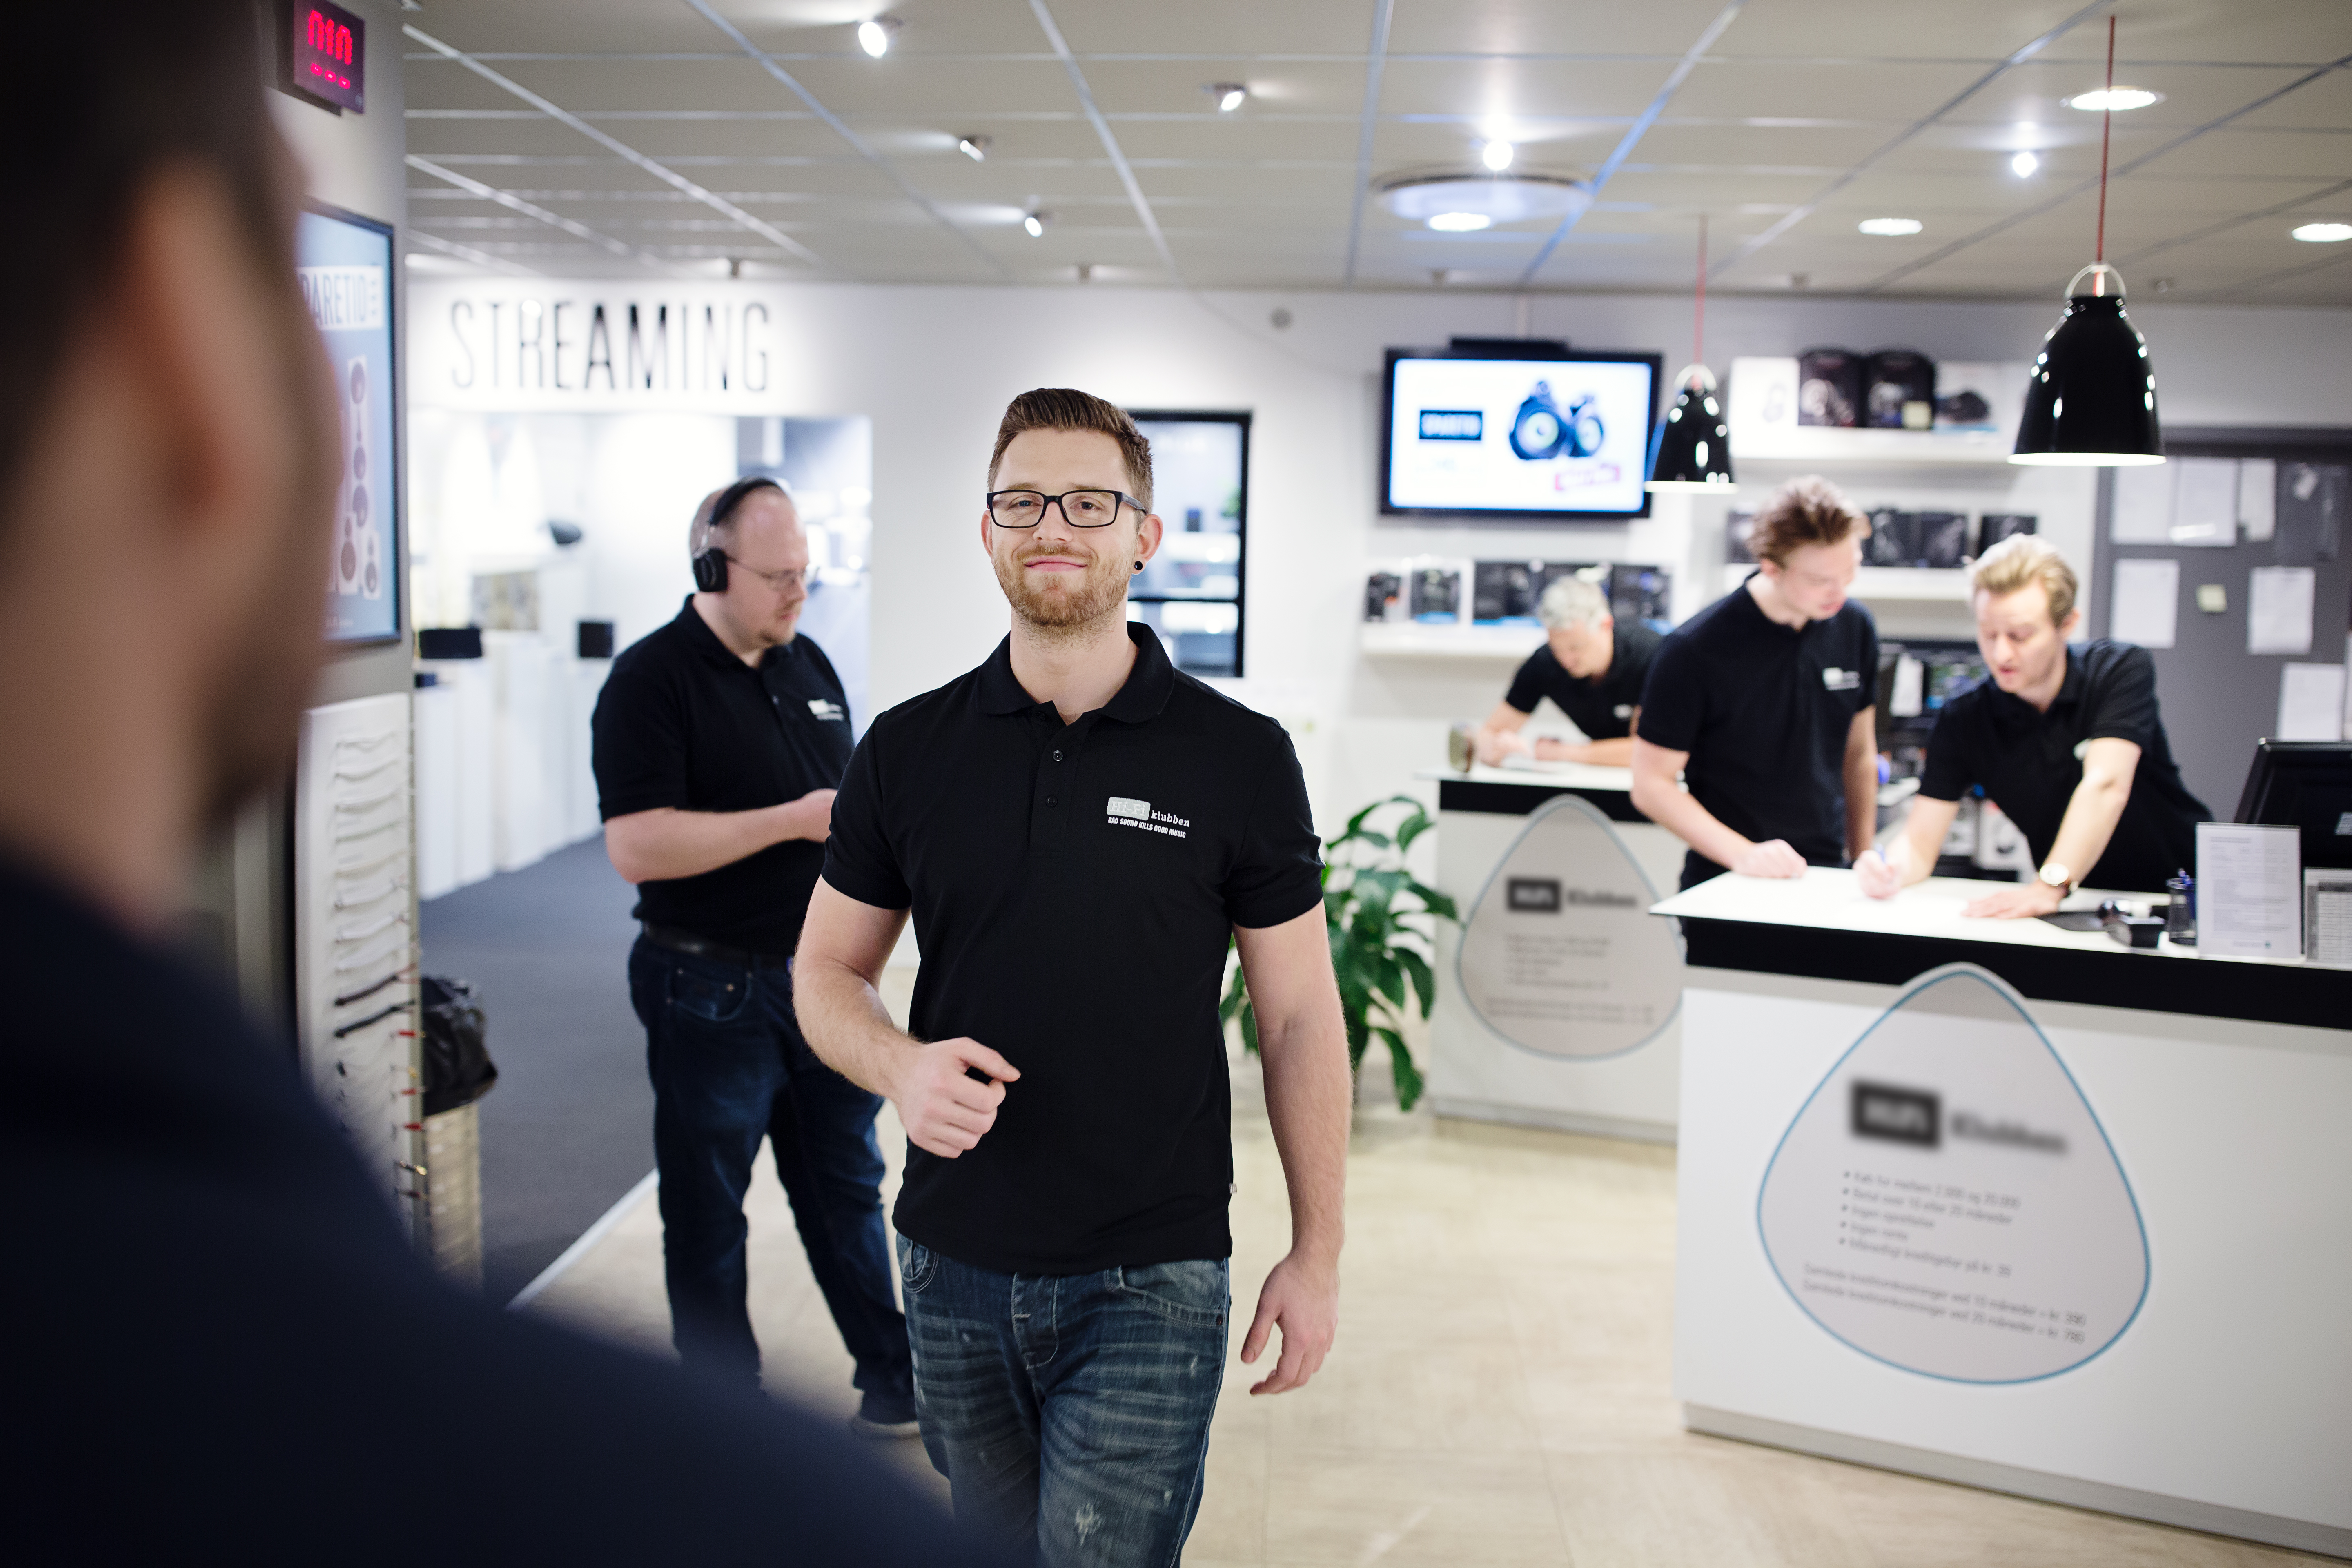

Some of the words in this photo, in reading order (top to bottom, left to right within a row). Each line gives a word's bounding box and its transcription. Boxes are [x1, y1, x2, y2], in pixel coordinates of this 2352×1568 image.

[451, 299, 769, 391] STREAMING
[1109, 801, 1146, 817] Hi-Fi
[1150, 810, 1190, 827] klubben
[1120, 818, 1138, 827] SOUND
[1138, 821, 1153, 831] KILLS
[1154, 825, 1168, 834] GOOD
[1169, 828, 1186, 838] MUSIC
